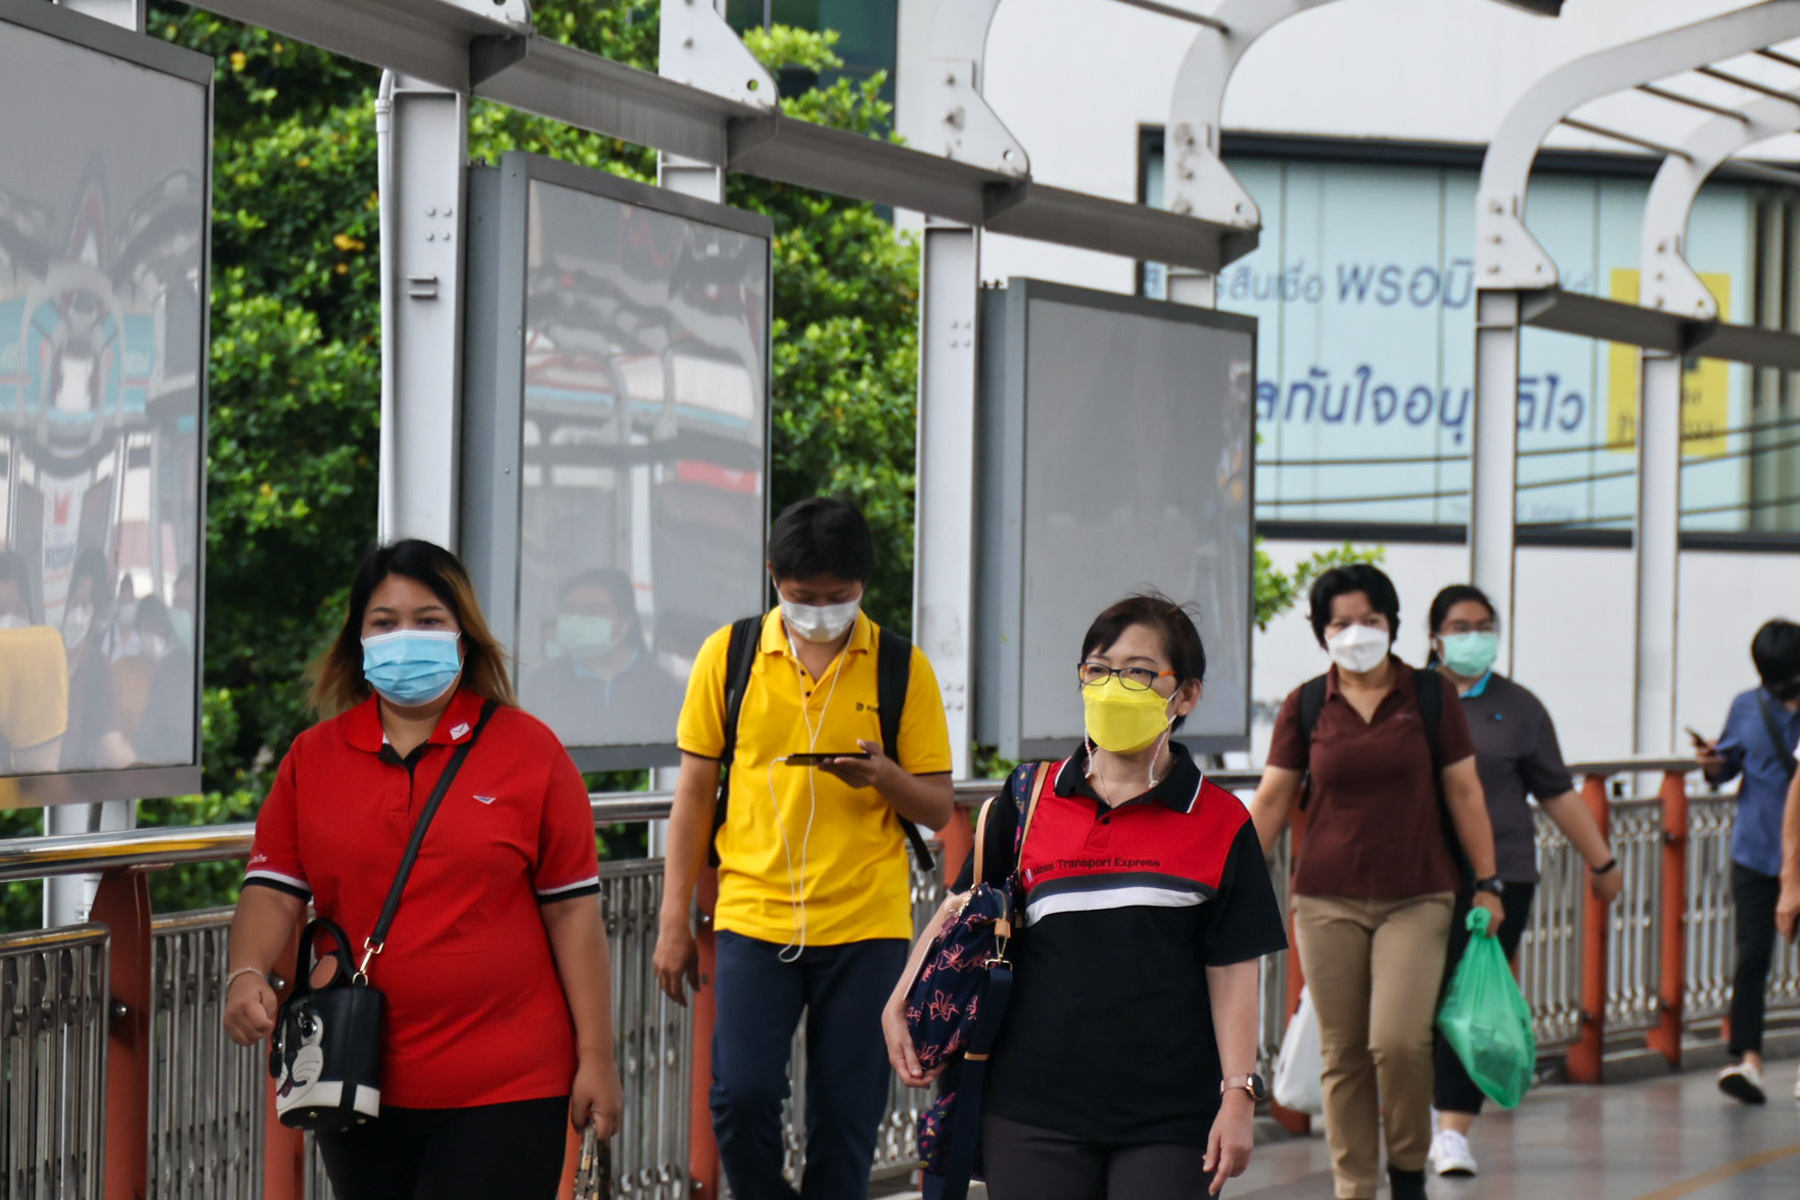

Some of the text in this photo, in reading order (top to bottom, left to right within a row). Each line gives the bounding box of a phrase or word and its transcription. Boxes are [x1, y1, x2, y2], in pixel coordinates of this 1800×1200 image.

[1336, 258, 1474, 309] พรอมิ
[1057, 859, 1112, 870] Transport
[1114, 858, 1161, 869] Express
